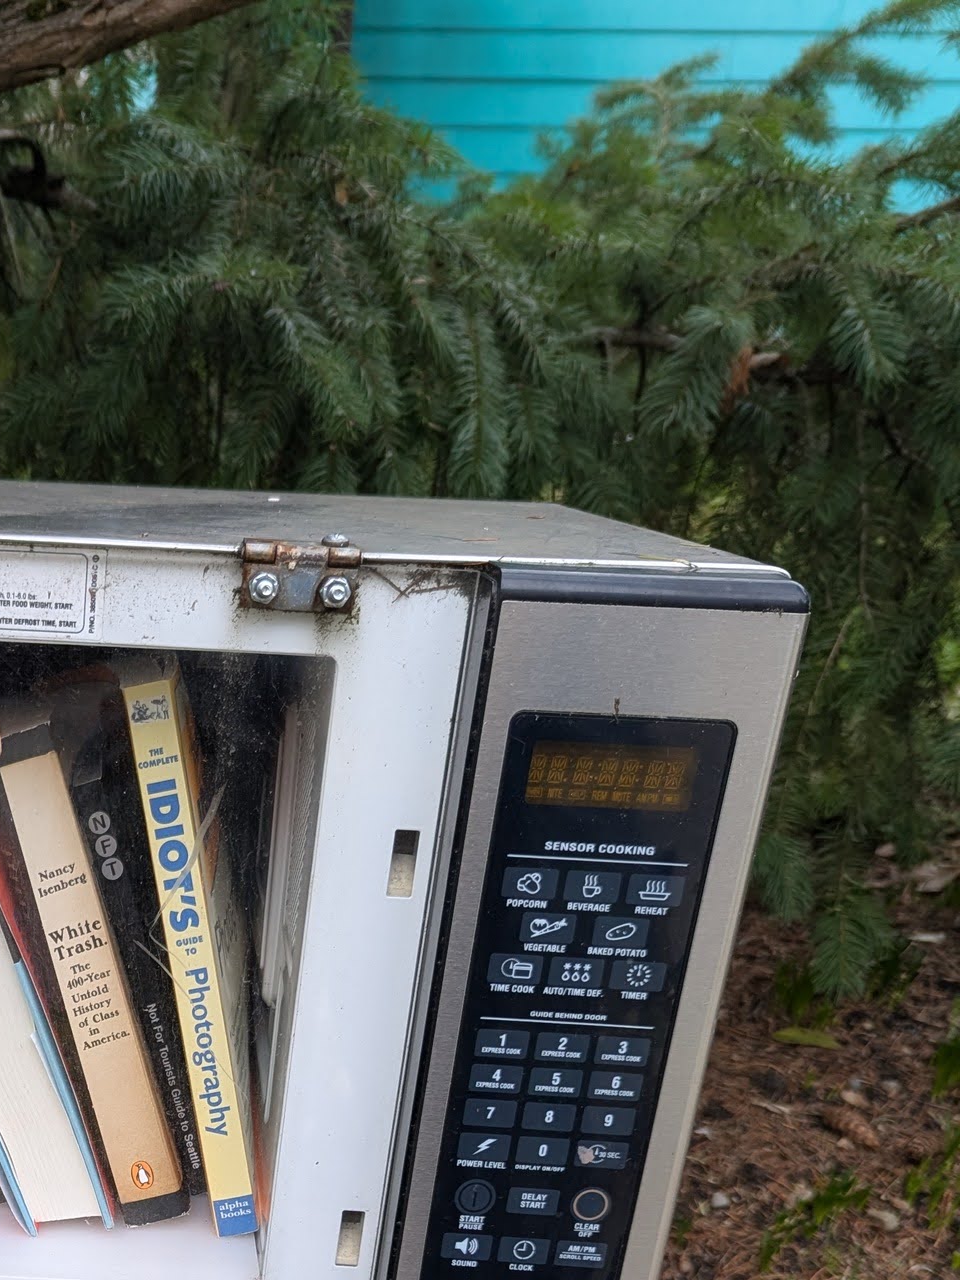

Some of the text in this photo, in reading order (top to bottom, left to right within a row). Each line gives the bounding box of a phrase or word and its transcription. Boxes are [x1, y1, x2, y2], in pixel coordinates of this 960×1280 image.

[149, 747, 164, 758] THE
[138, 754, 180, 770] COMPLETE
[544, 840, 656, 856] SENSOR COOKING
[146, 778, 200, 932] IDIOT'S
[38, 862, 76, 882] Nancy
[37, 873, 88, 898] Isenberg
[506, 899, 548, 908] POPCORN
[566, 902, 612, 912] BEVERAGE
[634, 906, 670, 916] REHEAT
[48, 919, 103, 946] White
[176, 935, 204, 947] GUIDE
[54, 934, 108, 962] Trash.
[184, 946, 197, 956] TO
[524, 943, 566, 953] VEGETABLE
[586, 946, 648, 958] BAKED POTATO
[70, 962, 92, 976] The
[66, 969, 112, 992] 400-Year
[71, 984, 110, 1004] Untold
[490, 984, 535, 994] TIME COOK
[542, 986, 604, 998] AUTO/TIME DEF.
[620, 991, 648, 1000] TIMER
[72, 998, 112, 1018] History
[78, 1009, 120, 1030] of Class
[530, 1010, 608, 1022] GUIDE BEHIND DOOR
[88, 1026, 100, 1037] in
[83, 1030, 130, 1051] America.
[499, 1033, 508, 1047] 1
[558, 1037, 569, 1050] 2
[185, 966, 231, 1137] Photography
[618, 1040, 629, 1054] 3
[492, 1068, 502, 1082] 4
[552, 1072, 562, 1086] 5
[147, 1002, 200, 1170] Not For Tourists Guide to Seattle
[611, 1076, 622, 1089] 6
[486, 1106, 496, 1120] 7
[544, 1110, 554, 1124] 8
[604, 1114, 614, 1127] 9
[538, 1144, 548, 1157] 0
[608, 1152, 622, 1160] SEC.
[456, 1159, 508, 1170] POWER LEVEL
[514, 1164, 541, 1172] DISPLAY
[521, 1192, 548, 1201] DELAY
[219, 1200, 249, 1212] alpha
[520, 1200, 546, 1209] START
[220, 1208, 252, 1219] books
[459, 1214, 486, 1223] START
[458, 1222, 484, 1230] PAUSE
[574, 1222, 600, 1231] CLEAR
[578, 1230, 593, 1238] OFF
[568, 1244, 596, 1254] AM/PM
[451, 1259, 478, 1268] SOUND
[558, 1253, 602, 1262] SCROLL SPEED
[508, 1263, 534, 1272] CLOCK
